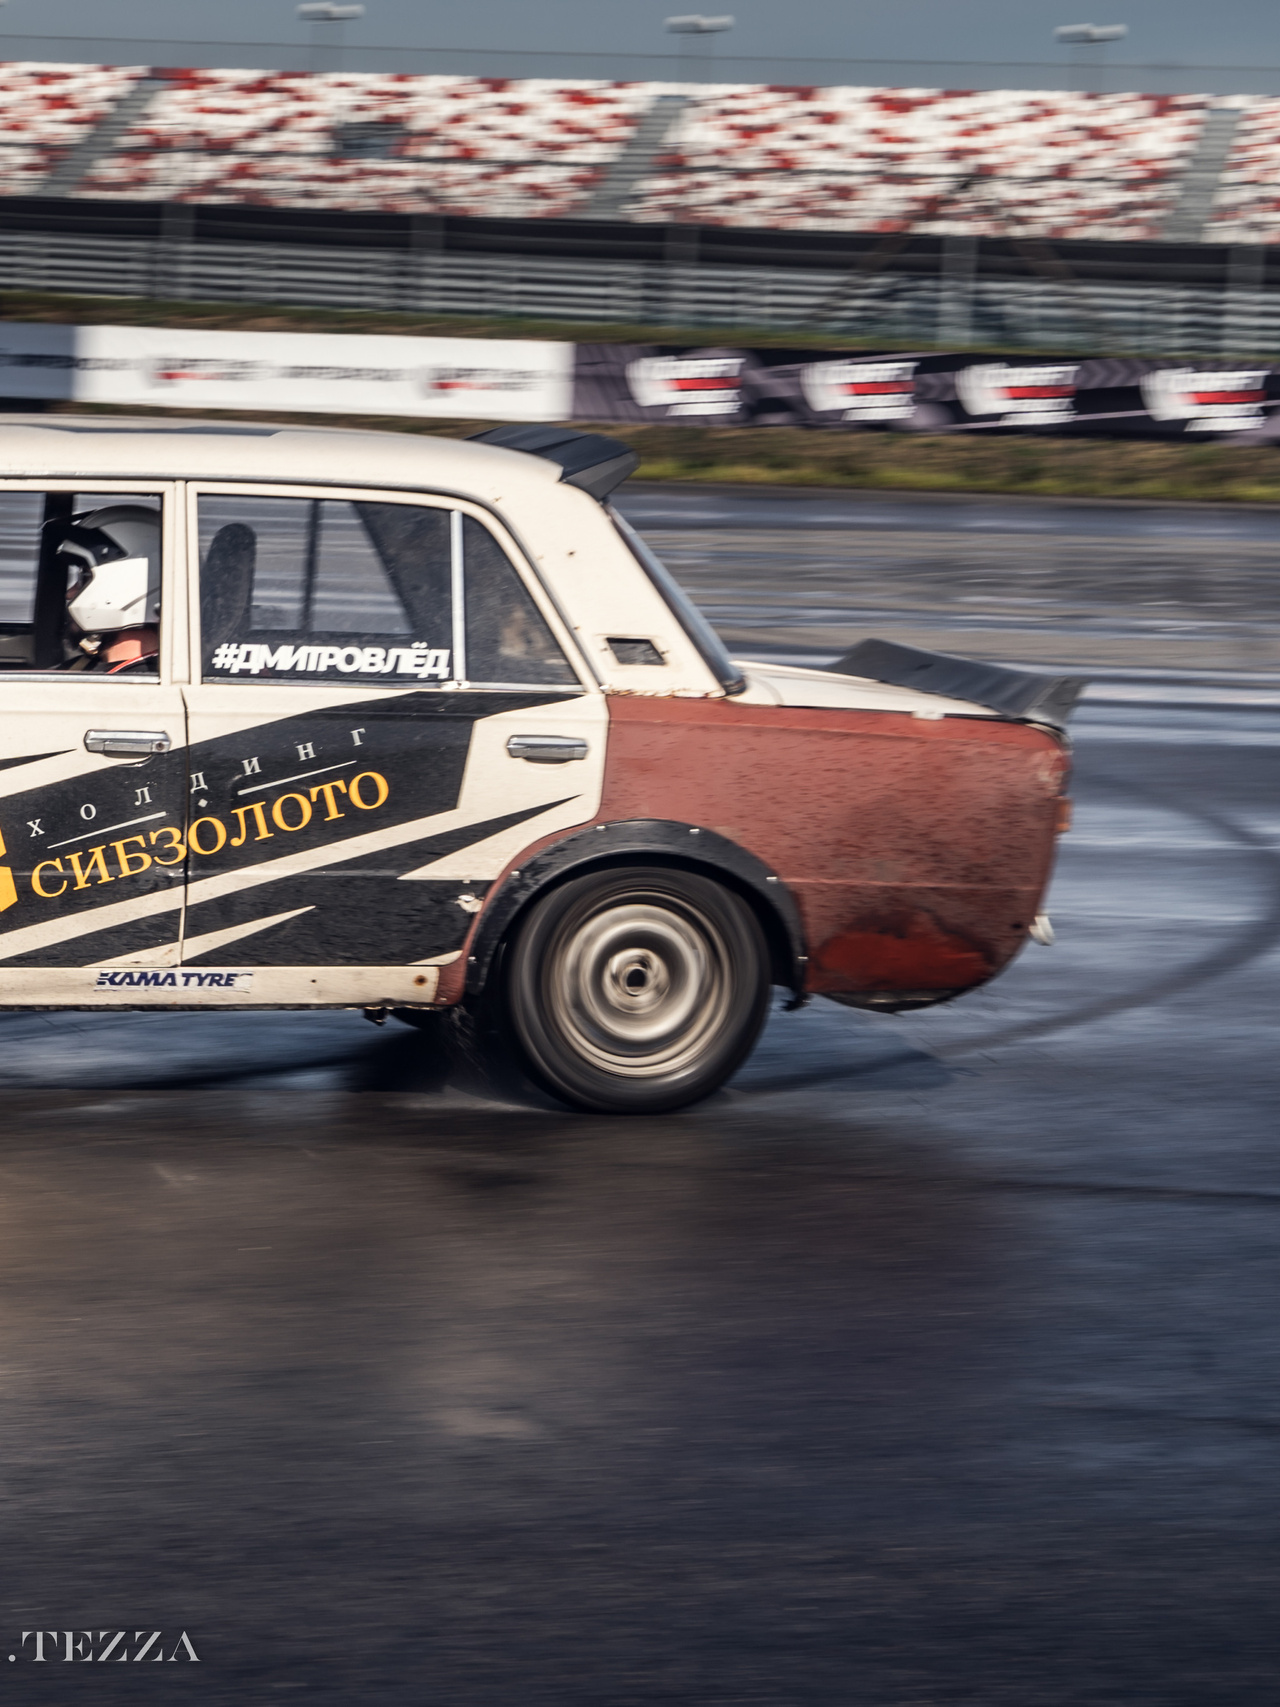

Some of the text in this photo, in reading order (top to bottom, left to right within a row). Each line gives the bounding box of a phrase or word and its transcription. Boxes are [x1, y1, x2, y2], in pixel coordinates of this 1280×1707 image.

[211, 641, 450, 679] #ДМИТРОВЛЁД
[30, 771, 390, 898] СИБЗОЛОТО
[96, 971, 177, 987] KAMA
